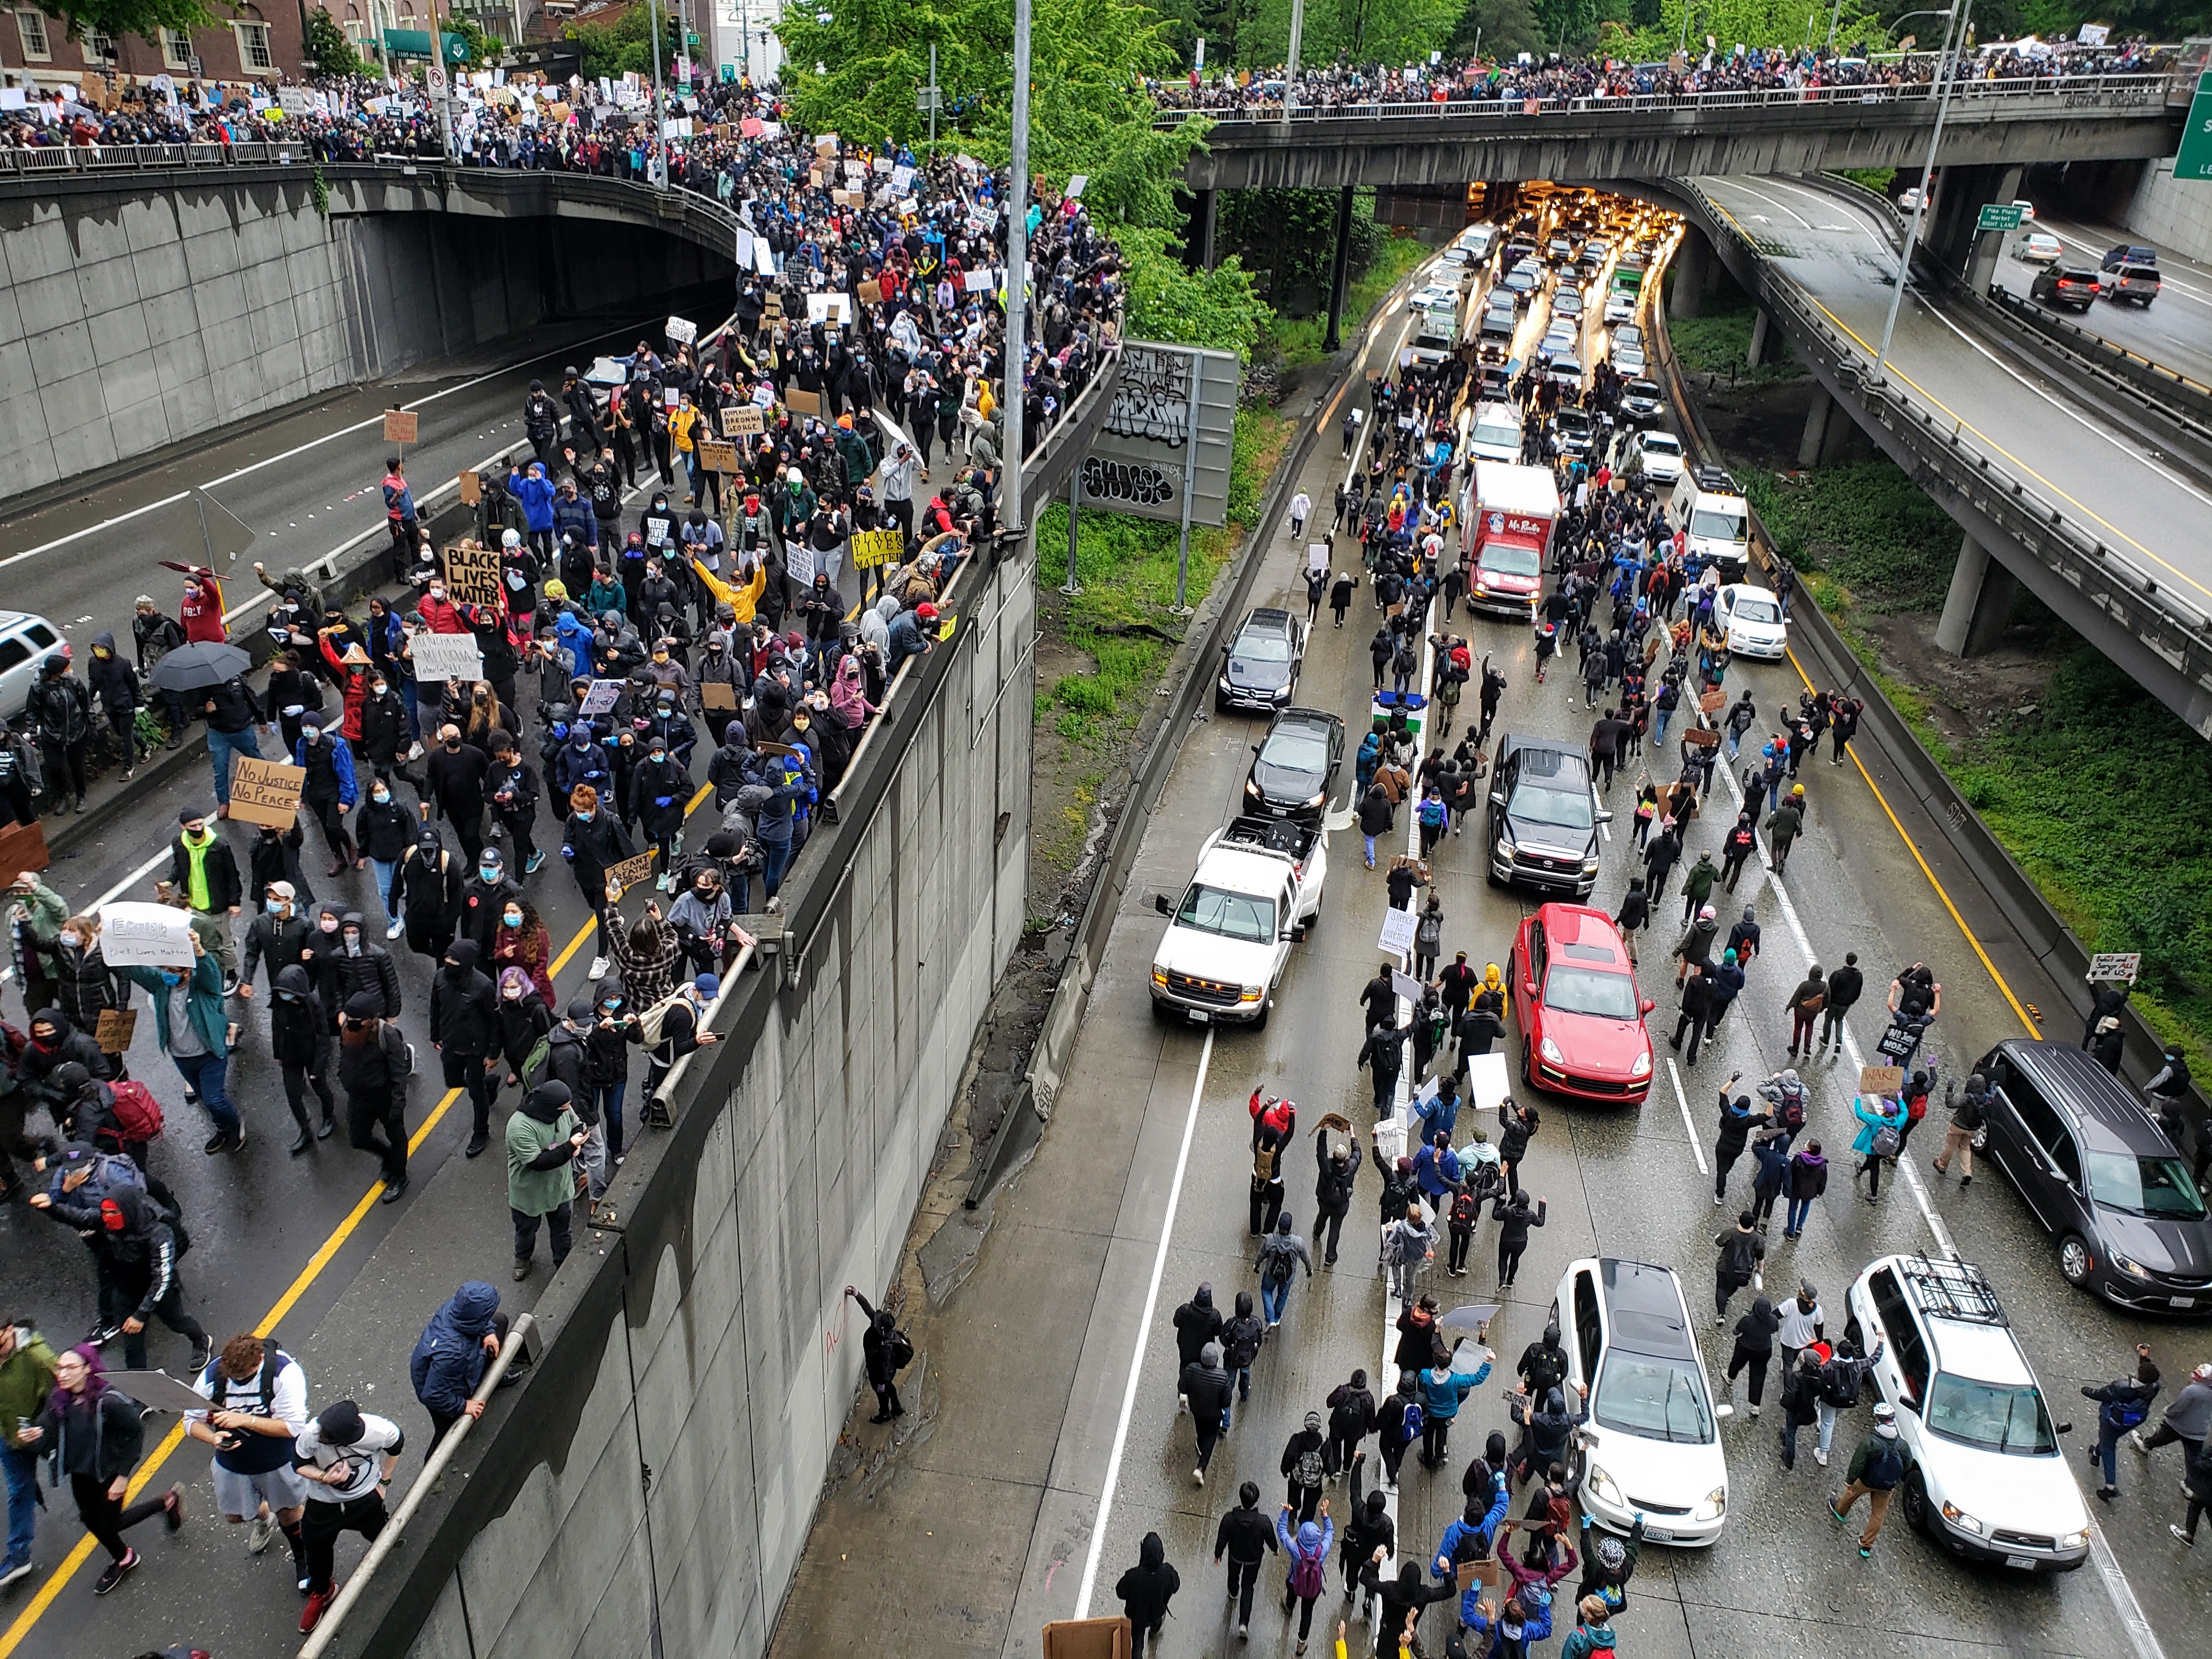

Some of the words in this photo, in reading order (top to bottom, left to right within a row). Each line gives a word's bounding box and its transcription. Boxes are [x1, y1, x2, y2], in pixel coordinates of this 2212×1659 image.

[847, 162, 865, 174] ACAB
[667, 330, 685, 341] MATTER
[724, 409, 752, 419] AHMAUD
[725, 416, 761, 428] BREONNA
[727, 423, 758, 433] GEORGE
[854, 532, 902, 548] BLACK
[854, 540, 903, 558] LIVES
[448, 549, 498, 570] BLACK
[449, 567, 500, 591] LIVES
[449, 585, 500, 606] MATTER
[236, 761, 259, 782] No
[258, 765, 302, 790] JUSTICE
[233, 783, 254, 800] No
[255, 787, 293, 806] PEACE
[1947, 802, 1967, 831] START
[610, 866, 618, 876] I
[622, 856, 648, 871] CANT
[611, 862, 651, 882] REATHE
[113, 918, 167, 940] Enough
[1391, 913, 1419, 929] Silence
[1396, 921, 1408, 932] IS
[1383, 927, 1412, 945] violence!
[109, 947, 131, 957] Black
[136, 946, 156, 956] Lives
[160, 947, 189, 956] Matter
[1888, 1028, 1902, 1040] NO
[1883, 1040, 1897, 1049] NO
[1865, 1069, 1898, 1081] WAKE
